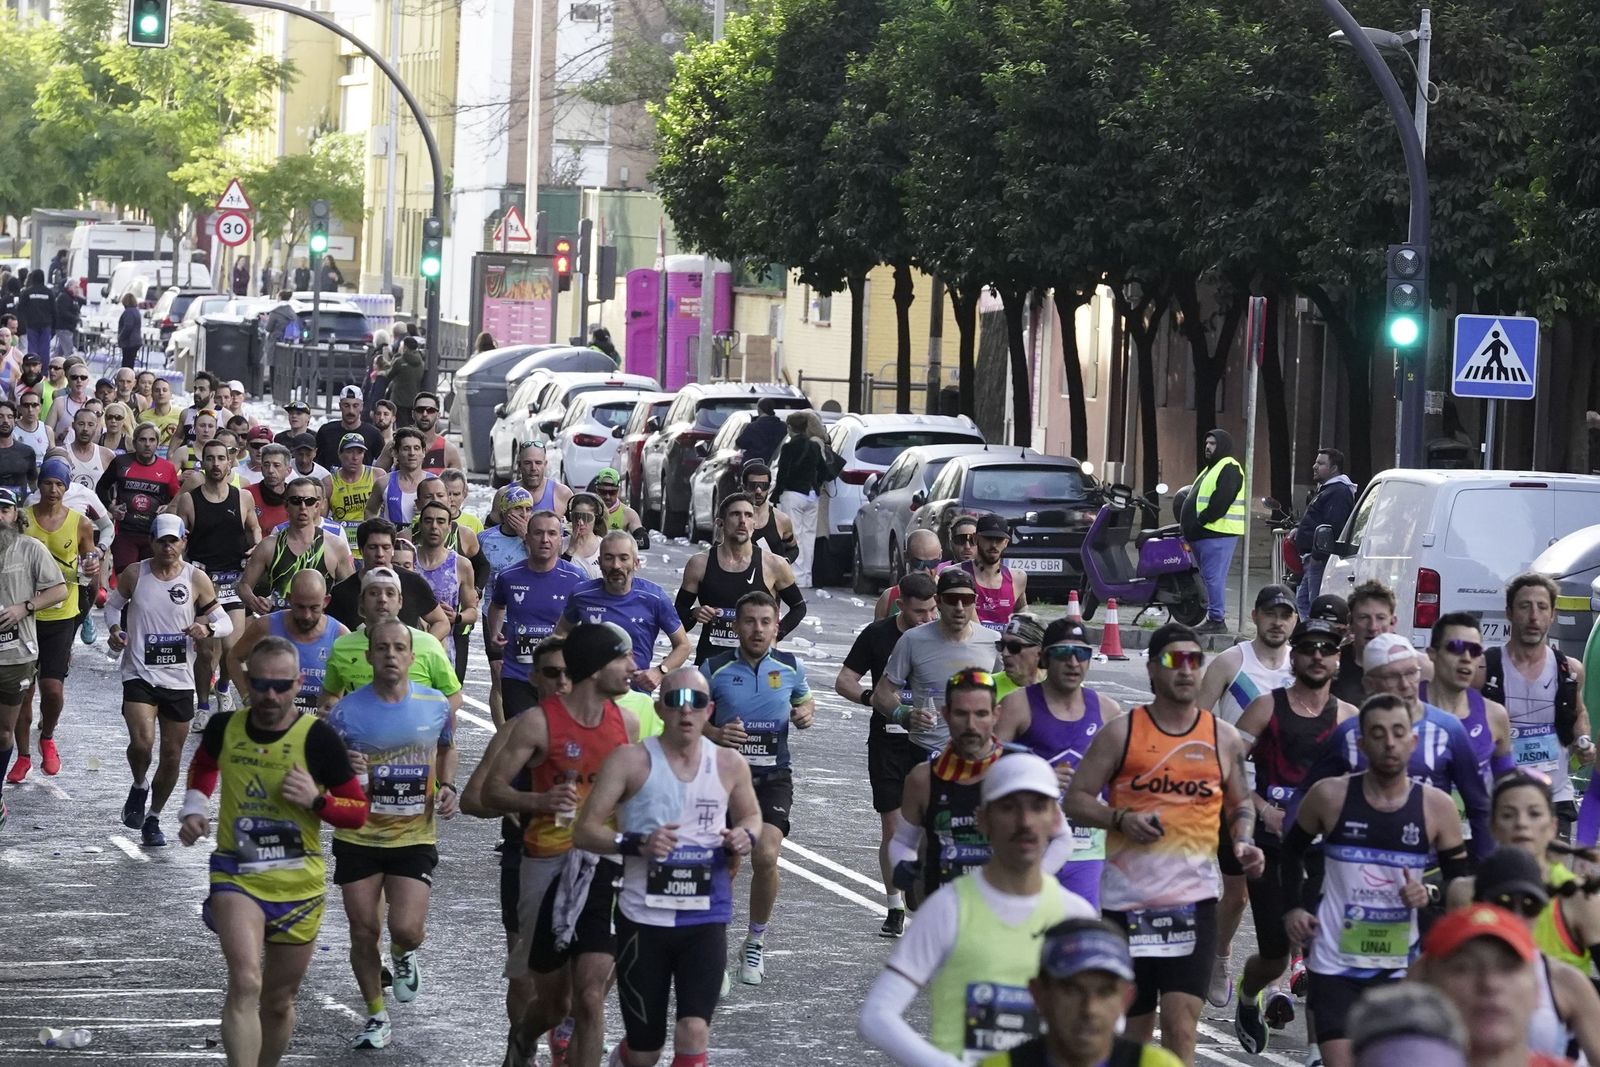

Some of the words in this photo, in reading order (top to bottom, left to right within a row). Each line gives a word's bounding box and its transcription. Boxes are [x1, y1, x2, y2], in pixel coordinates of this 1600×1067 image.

[223, 222, 244, 235] 30
[1011, 559, 1037, 570] 4249
[1040, 560, 1060, 571] GBR
[217, 589, 237, 598] ARCE
[710, 628, 726, 638] JAVI
[1482, 623, 1499, 636] 77
[1503, 624, 1511, 637] M
[0, 631, 13, 642] GIO
[520, 646, 532, 655] LA
[156, 655, 177, 664] REFO
[294, 696, 306, 704] 204
[747, 720, 775, 729] ZURICH
[1522, 725, 1551, 736] ZURICH
[737, 744, 769, 756] ANGEL
[1516, 751, 1549, 763] JASON
[951, 816, 979, 828] RUN
[256, 846, 285, 860] TANI
[663, 881, 698, 895] JOHN
[1128, 934, 1165, 946] MIGUEL
[1360, 941, 1392, 953] UNAI
